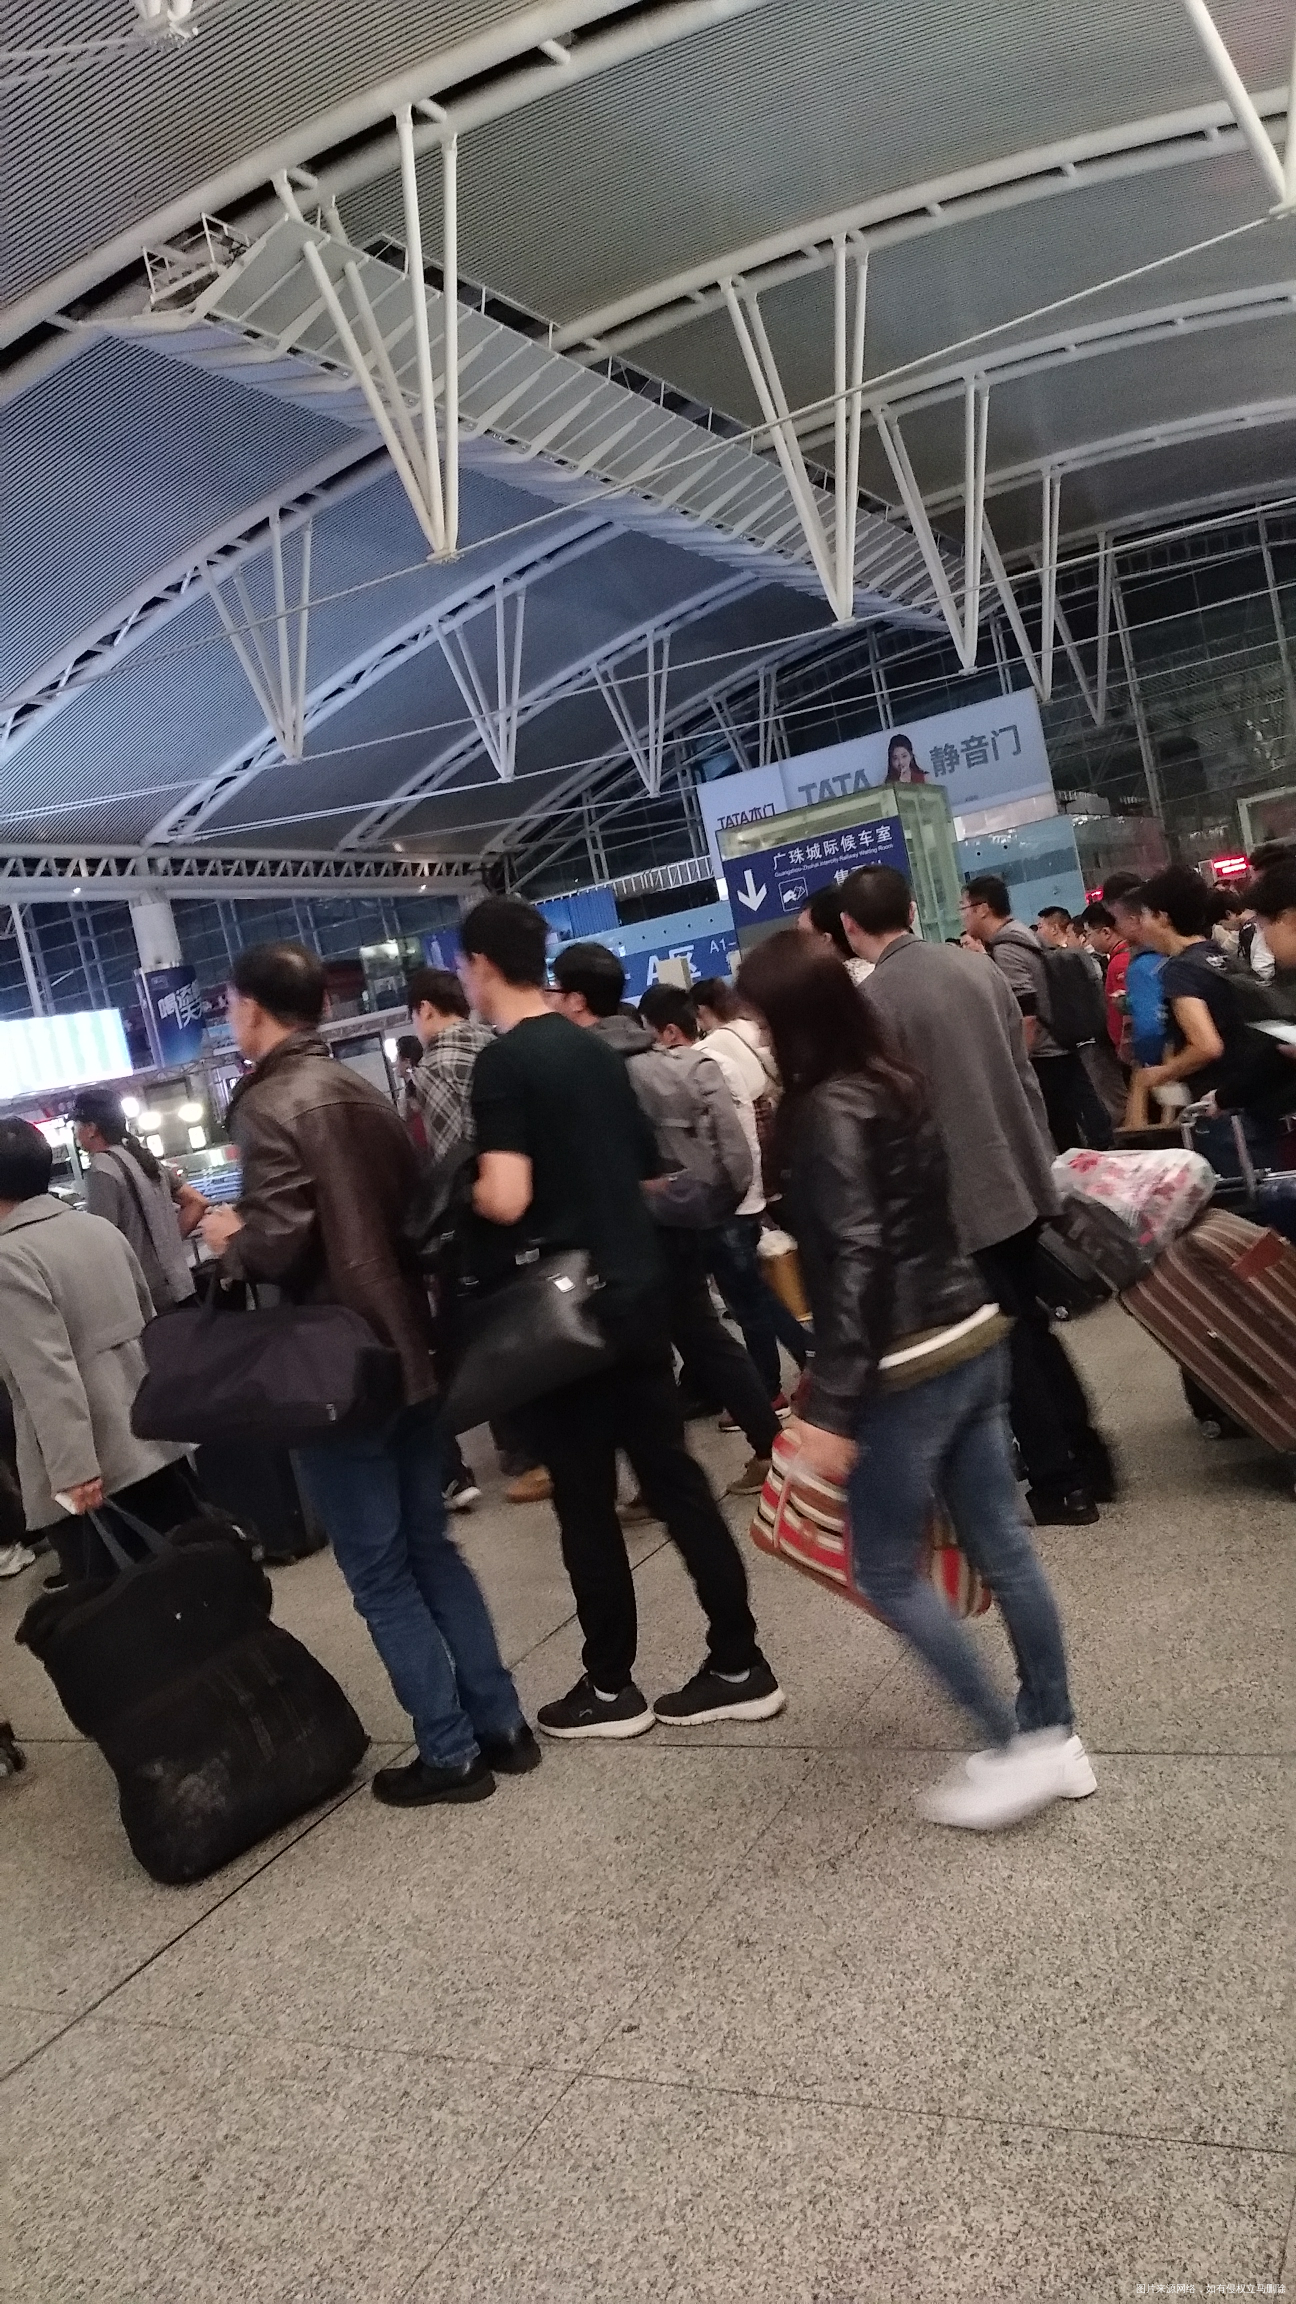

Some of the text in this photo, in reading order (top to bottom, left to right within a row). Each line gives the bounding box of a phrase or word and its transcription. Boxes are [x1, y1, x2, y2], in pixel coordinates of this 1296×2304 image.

[798, 724, 1022, 806] TATA 静音门
[773, 825, 893, 871] 广珠城际候车室
[878, 842, 894, 852] Room
